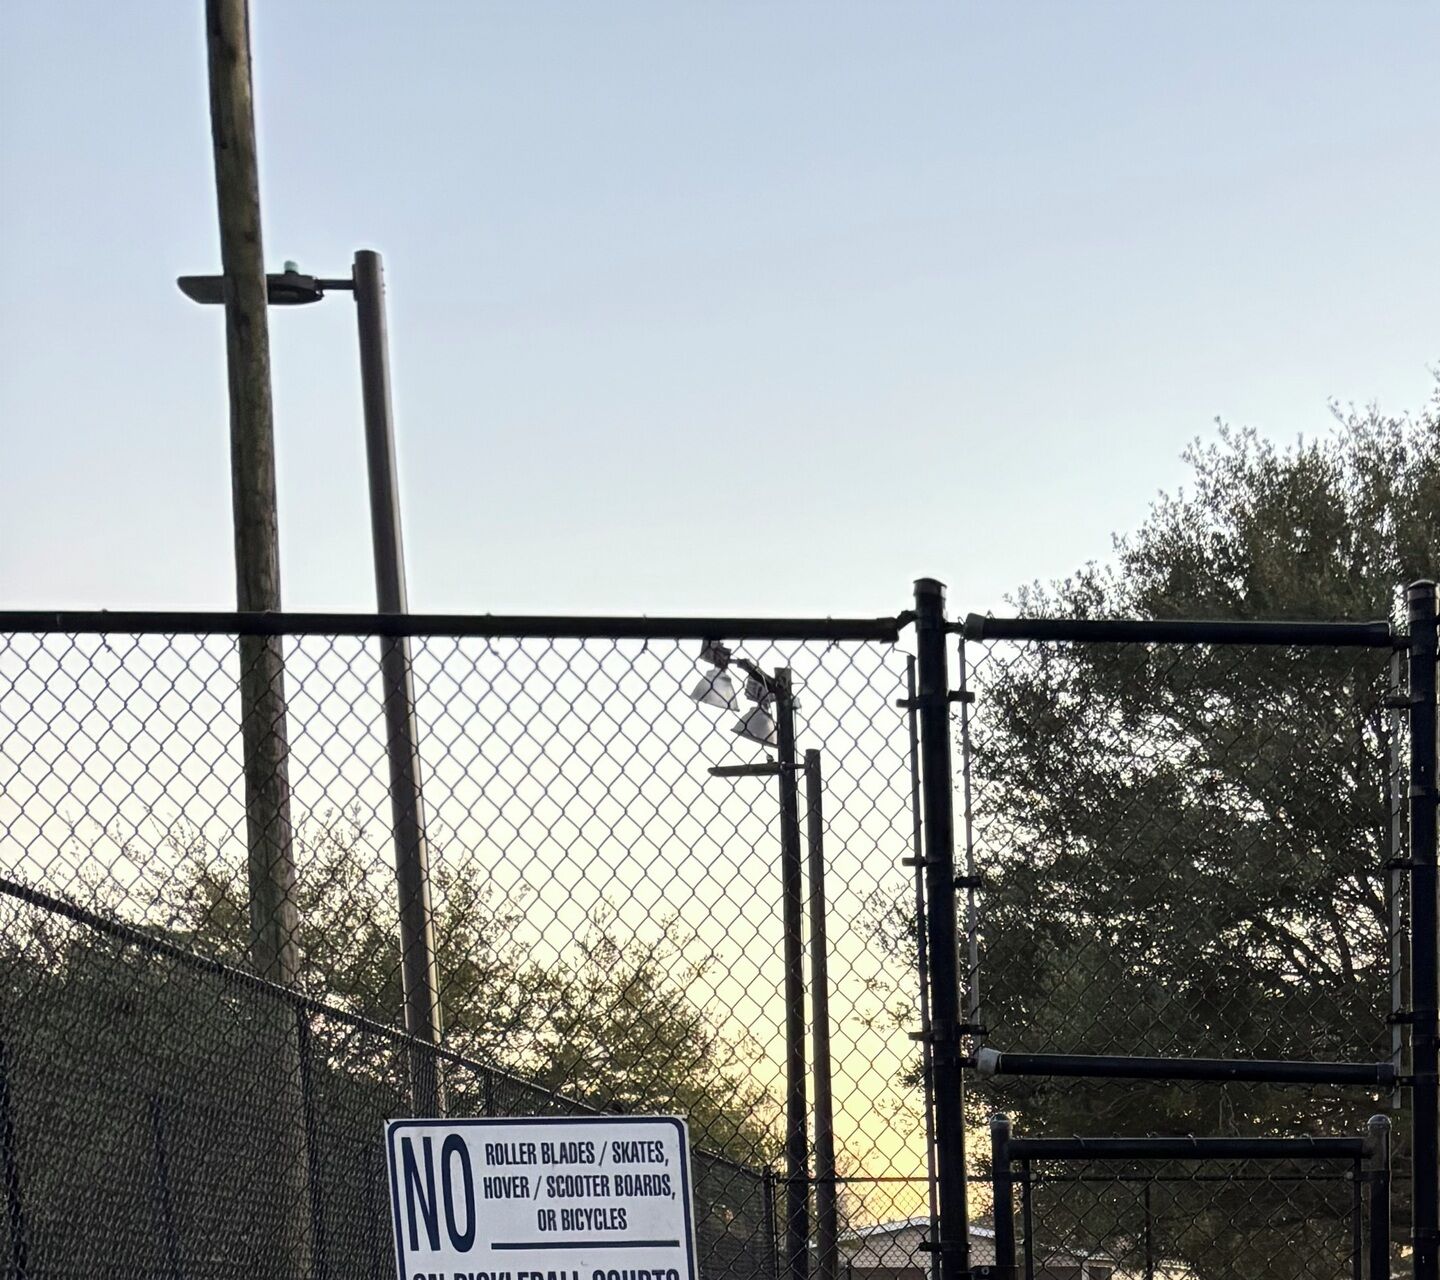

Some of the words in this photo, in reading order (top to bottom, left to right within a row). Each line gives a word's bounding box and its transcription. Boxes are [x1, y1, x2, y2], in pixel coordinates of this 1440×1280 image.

[485, 1143, 537, 1166] ROLLER
[541, 1142, 595, 1164] BLADES
[612, 1141, 668, 1166] SKATES,
[401, 1134, 475, 1253] NO
[484, 1176, 530, 1199] HOVER
[547, 1175, 610, 1198] SCOOTER
[614, 1174, 675, 1200] BOARDS,
[538, 1209, 557, 1231] OR
[561, 1208, 627, 1230] BICYCLES
